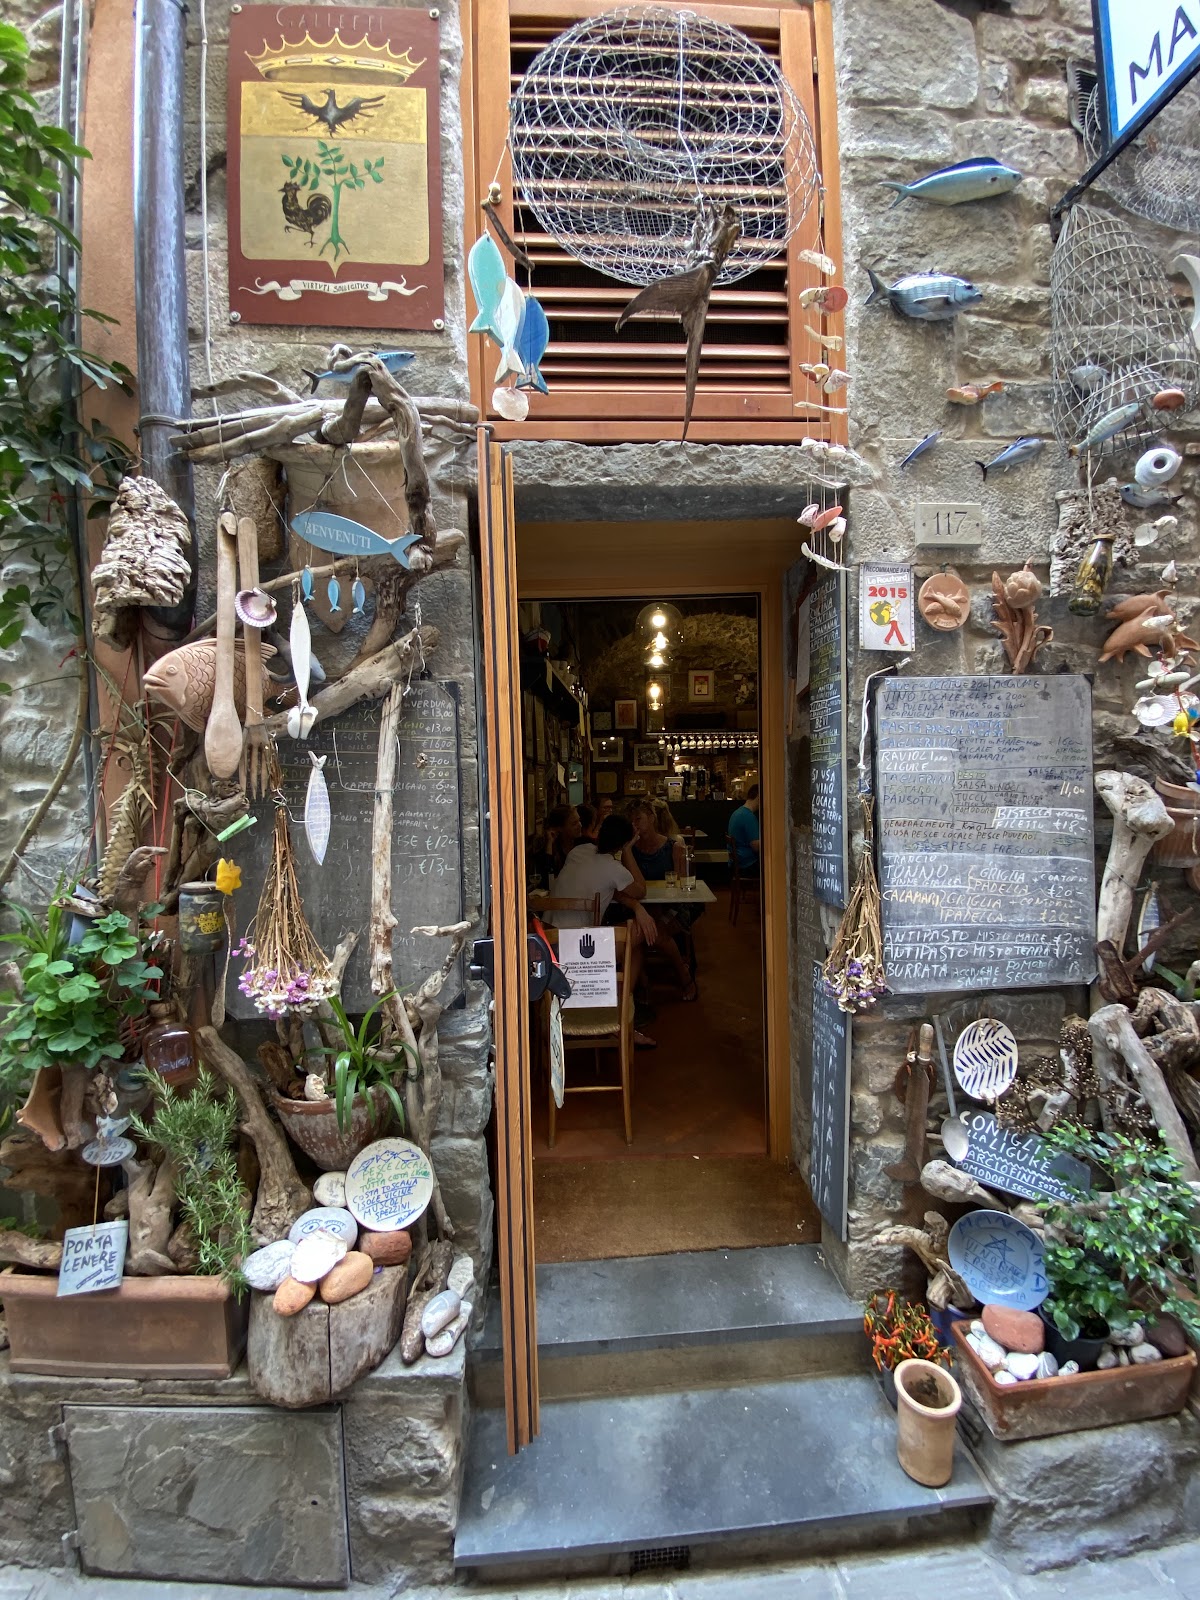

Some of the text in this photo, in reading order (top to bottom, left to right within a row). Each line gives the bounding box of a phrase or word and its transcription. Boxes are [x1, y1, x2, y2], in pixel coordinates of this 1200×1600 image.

[932, 511, 968, 536] 117
[304, 521, 371, 550] BENVENUTI
[876, 574, 908, 584] Routard
[868, 586, 907, 599] 2015
[411, 700, 453, 710] VERDURA
[881, 750, 934, 762] RAVIOLI
[885, 762, 928, 771] LIGURE
[815, 783, 834, 795] VINO
[957, 780, 987, 790] SALSA
[812, 795, 837, 810] LOCALE
[997, 808, 1052, 819] BISTECCA
[812, 819, 837, 837] BIANCO
[911, 830, 938, 838] PESCE
[939, 831, 974, 840] LOCALE
[976, 831, 1000, 840] PESCE
[951, 842, 987, 851] PESCE
[980, 867, 1026, 883] GRIGLIA
[974, 879, 1029, 894] PADELLA
[883, 889, 940, 906] CALAMARI
[946, 893, 1002, 909] GRIGLIA
[883, 929, 970, 944] ANTIPASTO
[883, 944, 969, 961] ANTIPASTO
[886, 961, 948, 979] BURRATA
[395, 1160, 428, 1171] LOCALE
[966, 1150, 1037, 1185] ARCIOFINI
[955, 1160, 1010, 1188] POMODORI
[352, 1188, 379, 1204] COSTA
[382, 1178, 418, 1193] TOSCANA
[360, 1178, 386, 1193] TUTTA
[357, 1187, 413, 1212] ISOLE VICINE
[375, 1202, 410, 1221] SPEZZINI
[65, 1234, 114, 1257] PORTA
